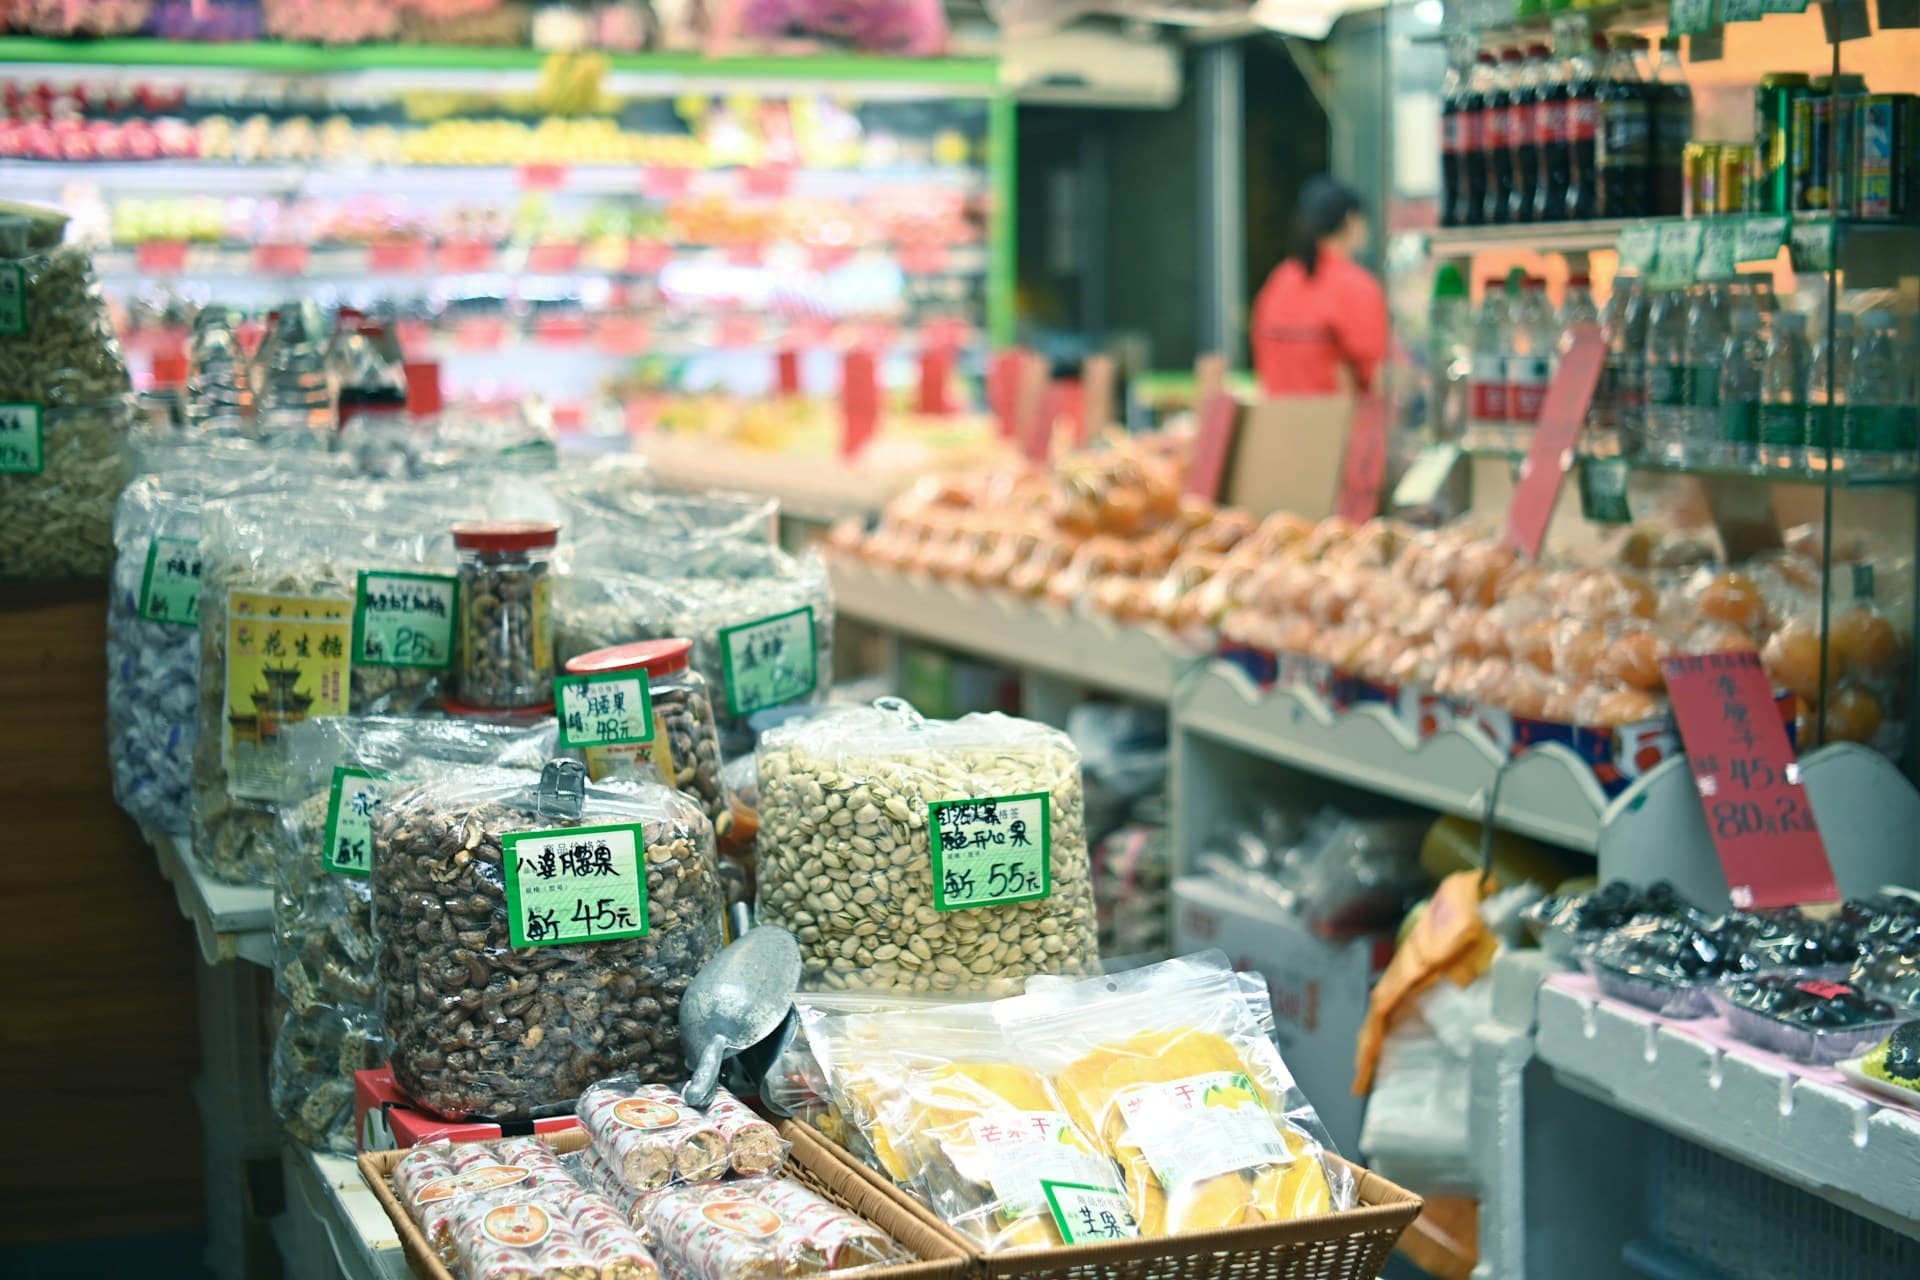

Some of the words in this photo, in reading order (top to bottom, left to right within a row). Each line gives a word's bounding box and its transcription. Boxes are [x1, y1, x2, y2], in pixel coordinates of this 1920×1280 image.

[262, 630, 343, 658] 花生糖
[988, 862, 1041, 898] 55元
[571, 898, 638, 936] 45元
